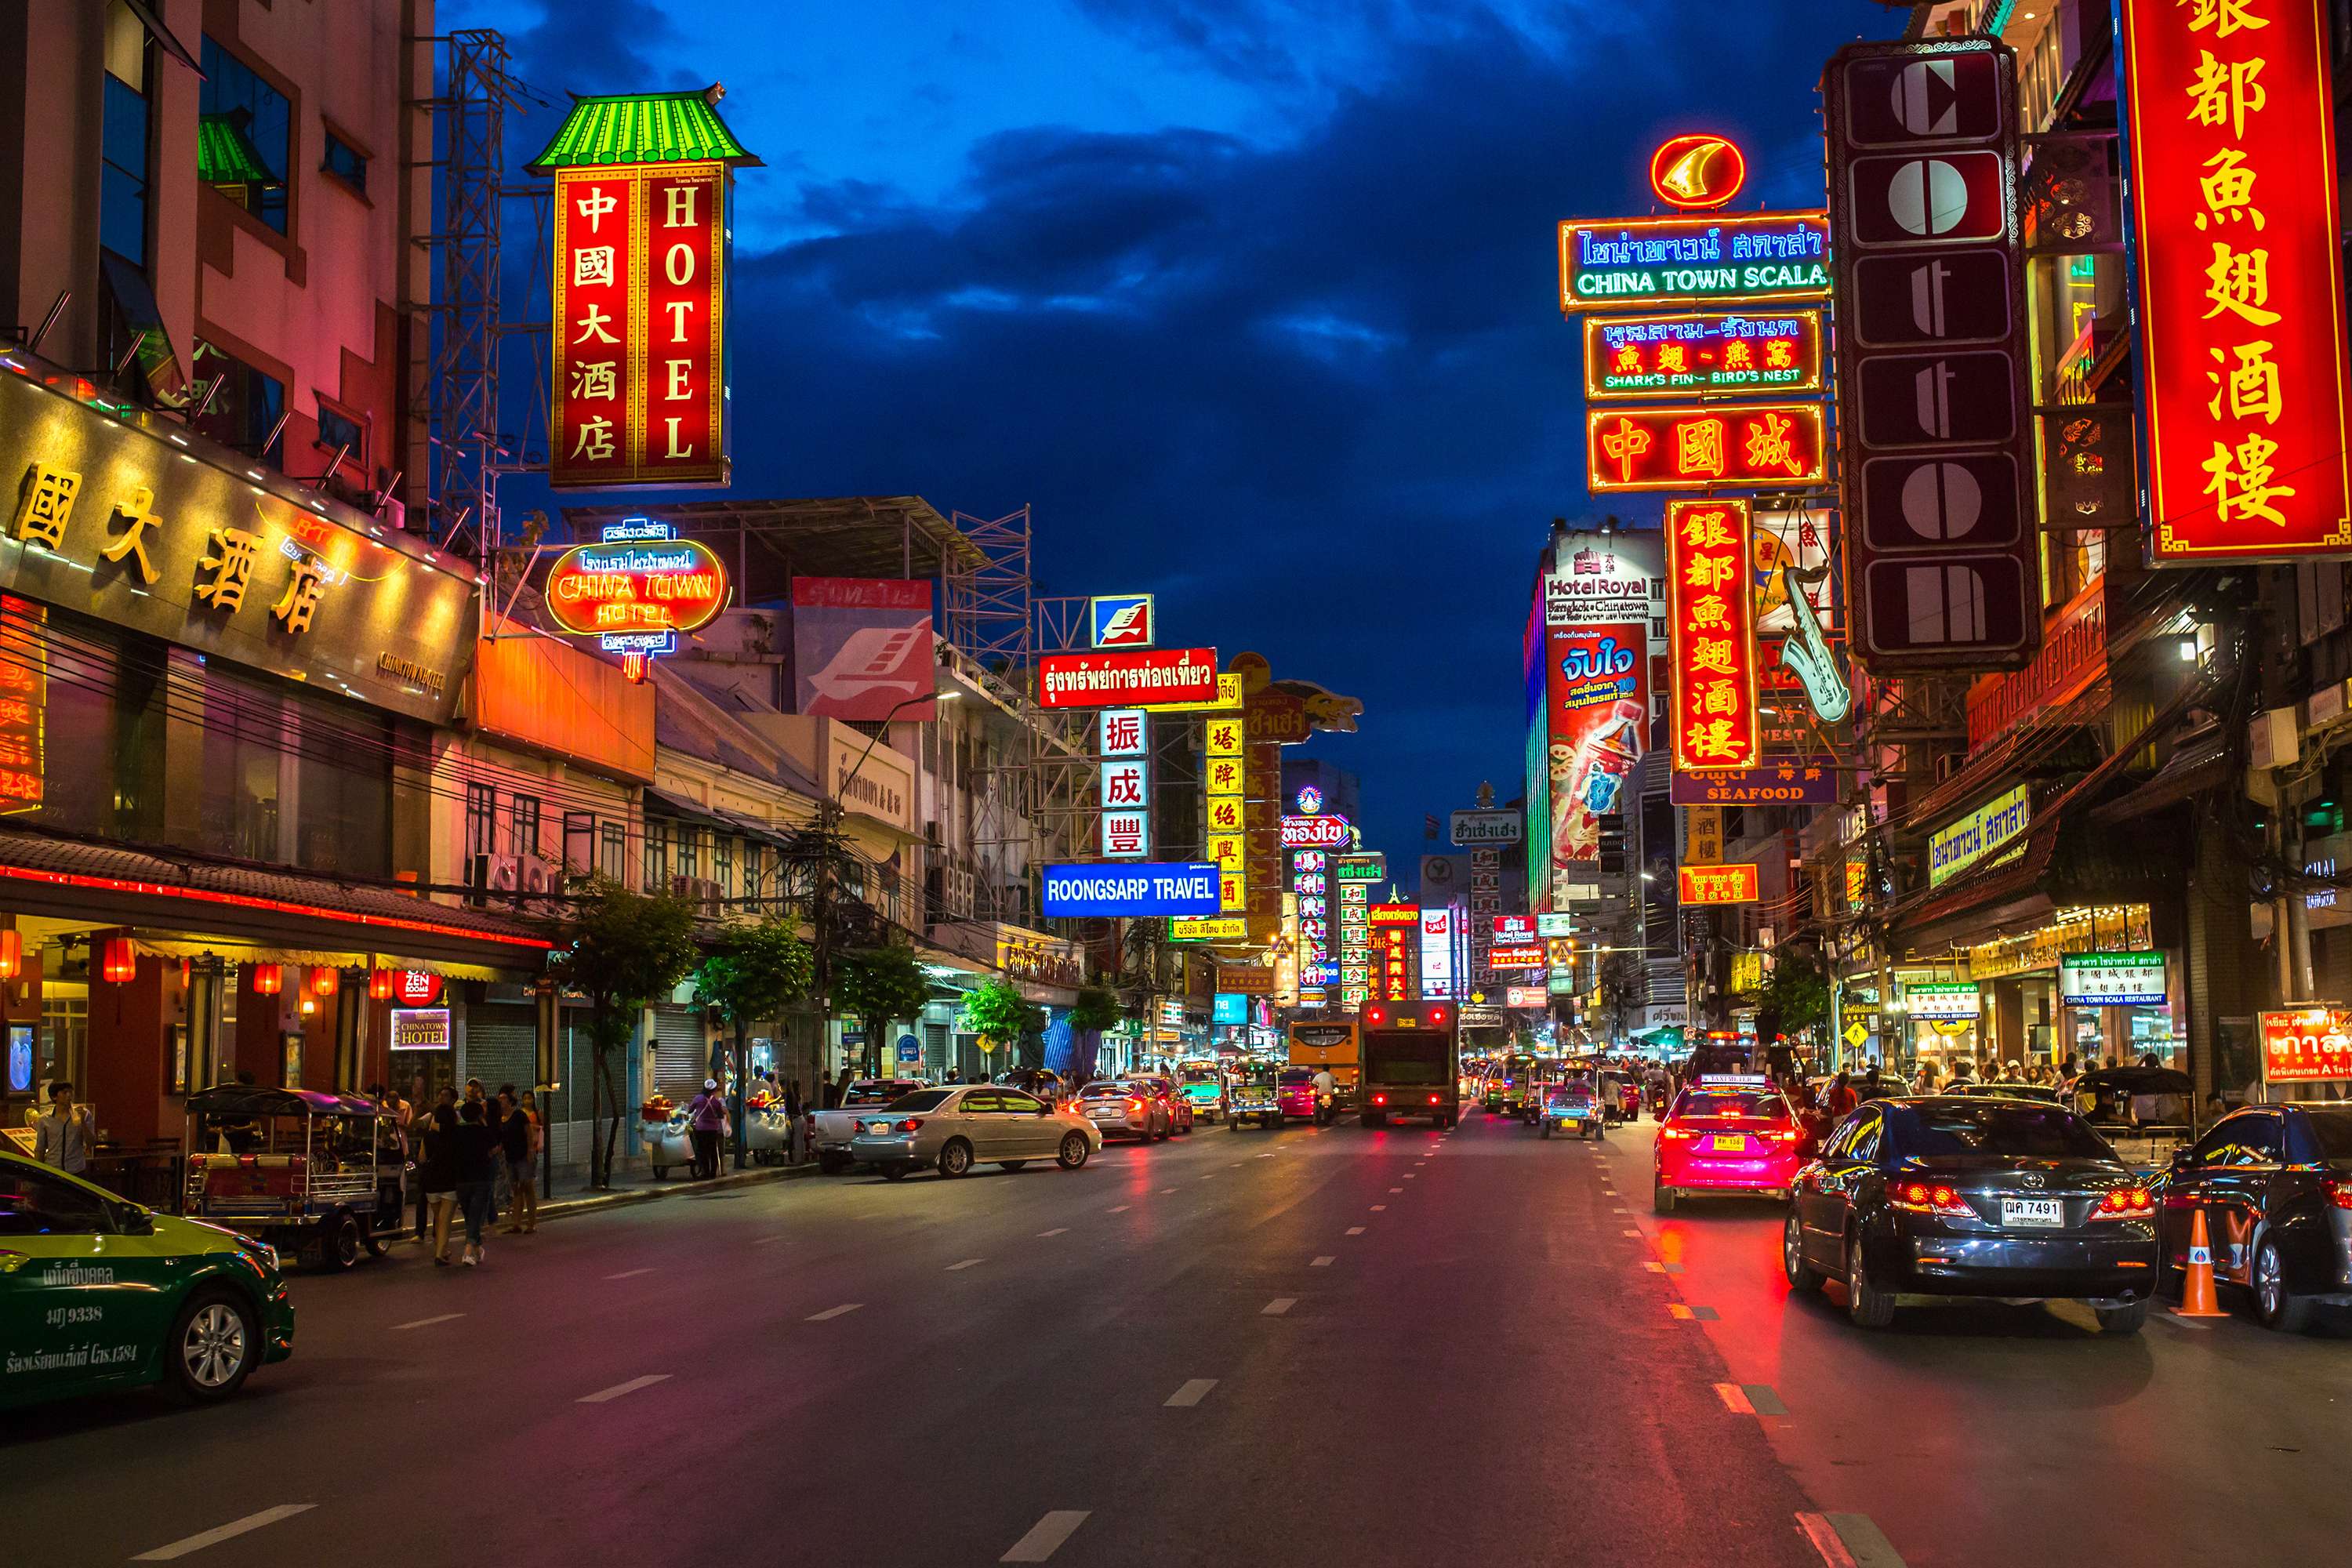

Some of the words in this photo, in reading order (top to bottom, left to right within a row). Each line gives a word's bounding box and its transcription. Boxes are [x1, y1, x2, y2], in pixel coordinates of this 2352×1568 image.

[1577, 228, 1719, 264] ไชน่าทาวน์
[1577, 272, 1655, 295] CHINA
[1662, 269, 1738, 290] TOWN
[1744, 264, 1828, 287] SCALA
[571, 187, 621, 461] 中國大酒店
[663, 187, 699, 459] HOTEL
[1606, 374, 1665, 387] SHARK'S
[1711, 371, 1759, 383] BIRD'S
[1764, 369, 1800, 381] NEST
[1603, 414, 1801, 481] 中國城
[558, 574, 636, 599] CHINA
[644, 574, 713, 598] TOWN
[1549, 579, 1595, 595] Hotel
[1599, 578, 1646, 596] Royal
[597, 604, 674, 625] HOTEL
[1681, 512, 1745, 758] 銀都魚翅酒樓
[1562, 637, 1635, 681] จับใจ
[1045, 651, 1210, 702] รุ่งทรัพย์การท่องเที่ยว
[1617, 677, 1636, 692] 10
[1107, 716, 1142, 852] 振成豐
[1708, 788, 1804, 799] SEAFOOD
[1281, 820, 1342, 842] ทองใบ
[1048, 877, 1149, 902] ROONGSARP
[1153, 876, 1214, 901] TRAVEL
[1178, 924, 1197, 934] บริษัท
[1222, 923, 1240, 933] จำกัด
[1428, 921, 1446, 932] SALE
[1348, 890, 1362, 1004] 和成興大金行
[2065, 956, 2096, 967] ภัตตาคาร
[2098, 956, 2135, 965] ไชน่าทาวน์
[405, 975, 430, 985] ZEN
[2076, 968, 2153, 978] 中國城銀都
[401, 1032, 448, 1044] HOTEL
[2321, 1064, 2331, 1075] A
[2028, 1202, 2057, 1214] 7491
[43, 1261, 114, 1291] แท็กซี่บุคคล
[68, 1306, 102, 1323] 9338
